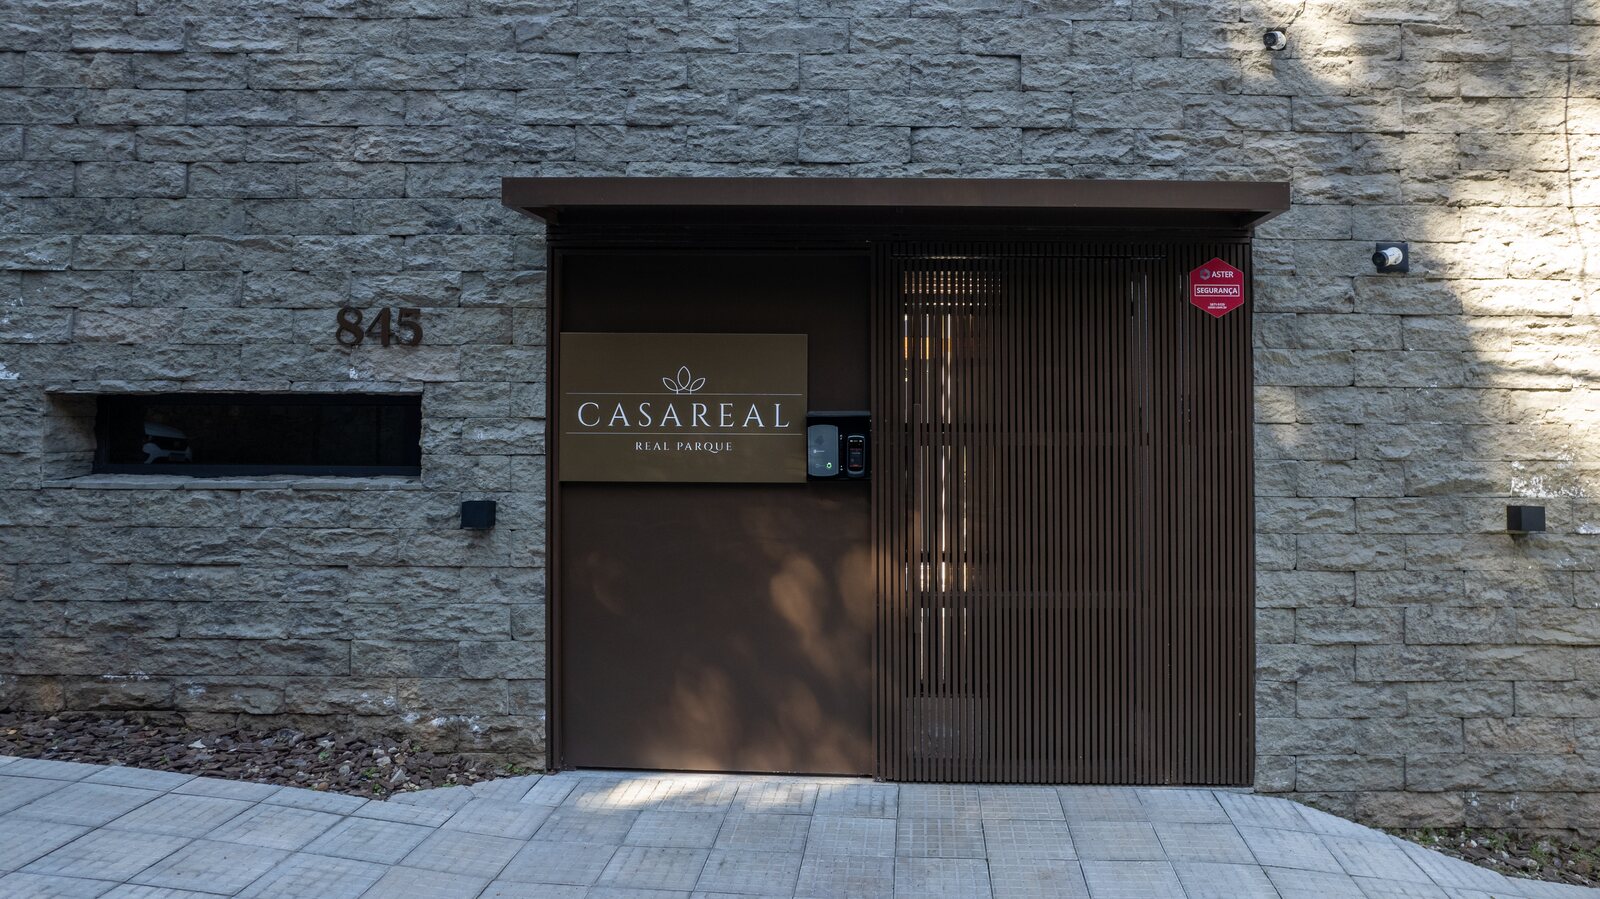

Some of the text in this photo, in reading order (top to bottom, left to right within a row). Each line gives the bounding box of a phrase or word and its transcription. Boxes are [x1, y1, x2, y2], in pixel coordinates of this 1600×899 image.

[1196, 288, 1238, 296] SEGURANÇA
[336, 306, 423, 347] 845
[577, 402, 790, 429] CASAREAL
[635, 441, 732, 454] REAL PARQUE
